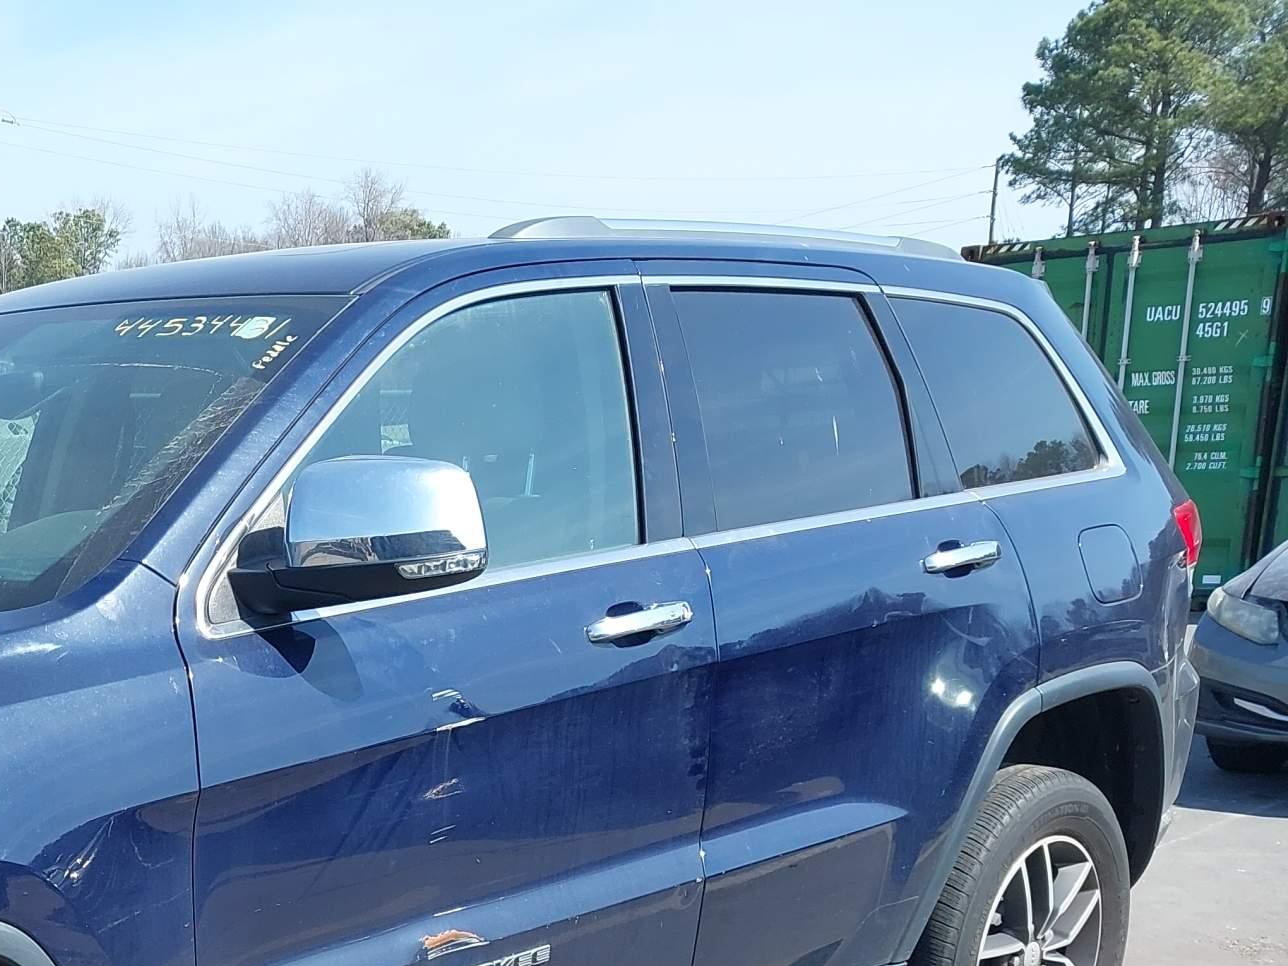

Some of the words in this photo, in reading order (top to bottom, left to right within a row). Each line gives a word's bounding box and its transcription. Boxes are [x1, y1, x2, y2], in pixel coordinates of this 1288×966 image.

[1146, 305, 1181, 322] UACU
[1198, 300, 1249, 319] 524495
[1261, 297, 1272, 315] 9
[1196, 321, 1229, 338] 45G1
[1219, 366, 1233, 374] KGS
[1152, 371, 1175, 386] GROSS
[1219, 375, 1233, 384] LBS
[1215, 394, 1230, 403] KGS
[1129, 400, 1150, 415] TARE
[1212, 423, 1227, 431] KGS
[1211, 433, 1225, 441] LBS
